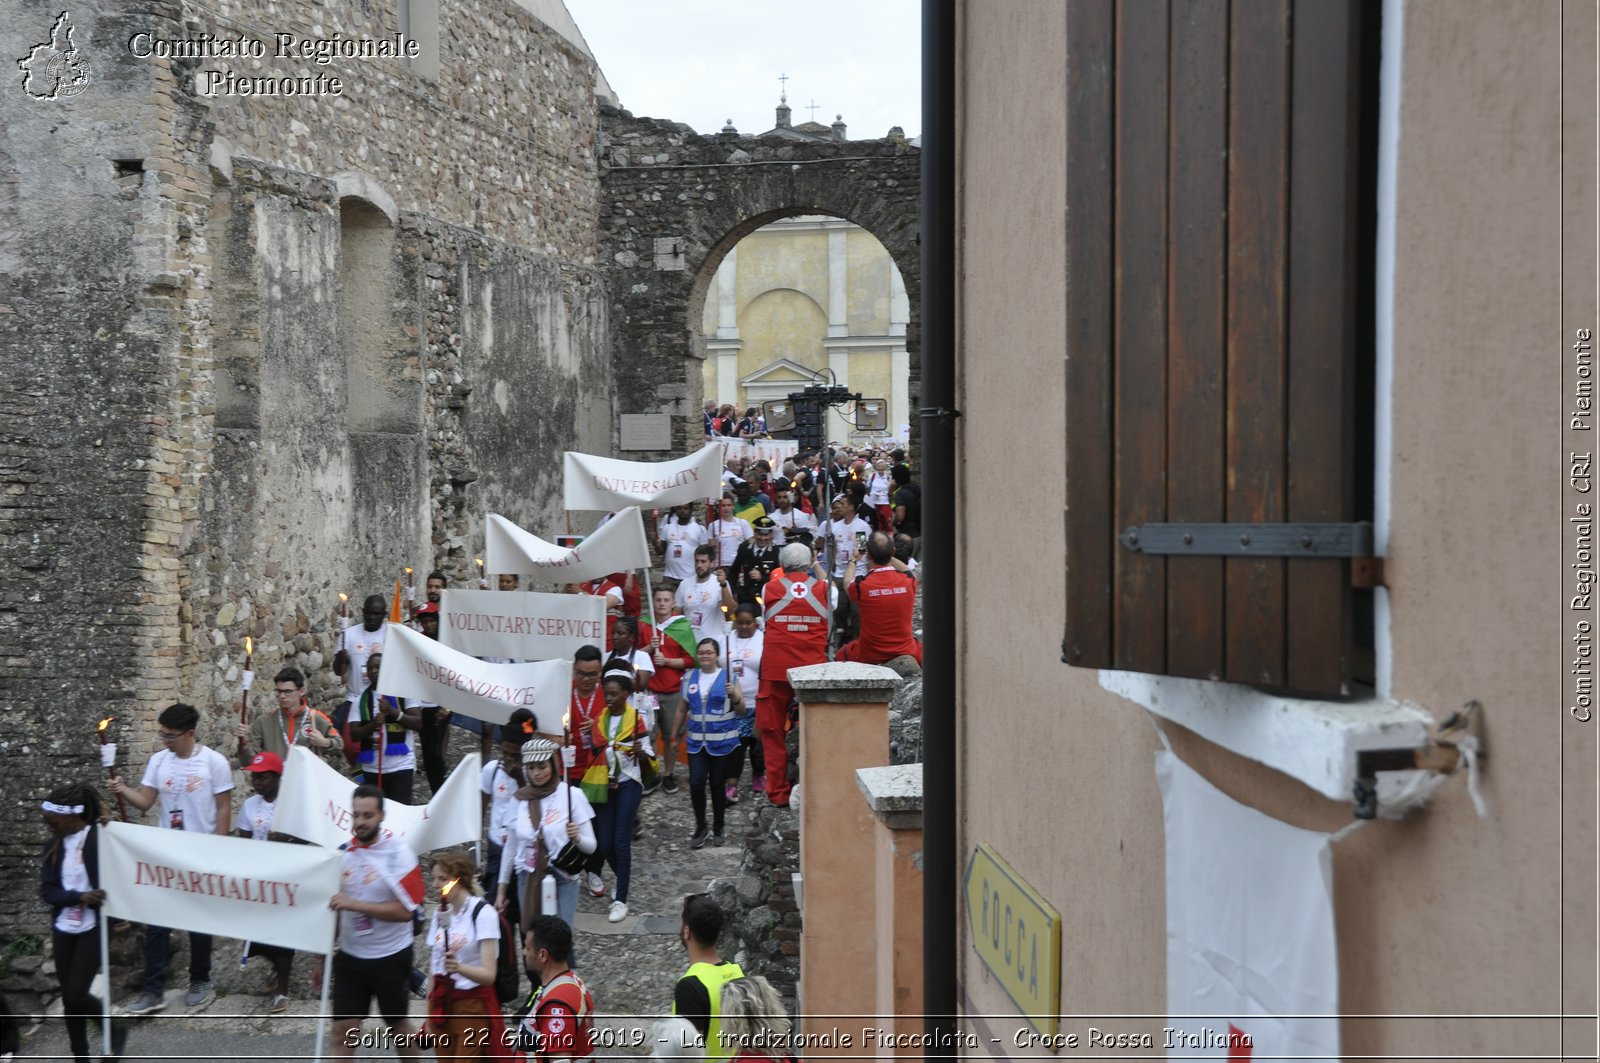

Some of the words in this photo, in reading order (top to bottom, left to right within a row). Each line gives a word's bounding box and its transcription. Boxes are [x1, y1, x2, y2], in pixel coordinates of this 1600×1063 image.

[593, 467, 699, 495] UNIVERSALITY
[448, 612, 533, 635] VOLUNTARY
[537, 616, 601, 639] SERVICE
[416, 656, 536, 706] INDEPENDENCE
[135, 861, 299, 907] IMPARTIALITY
[982, 878, 1039, 1001] ROCCA
